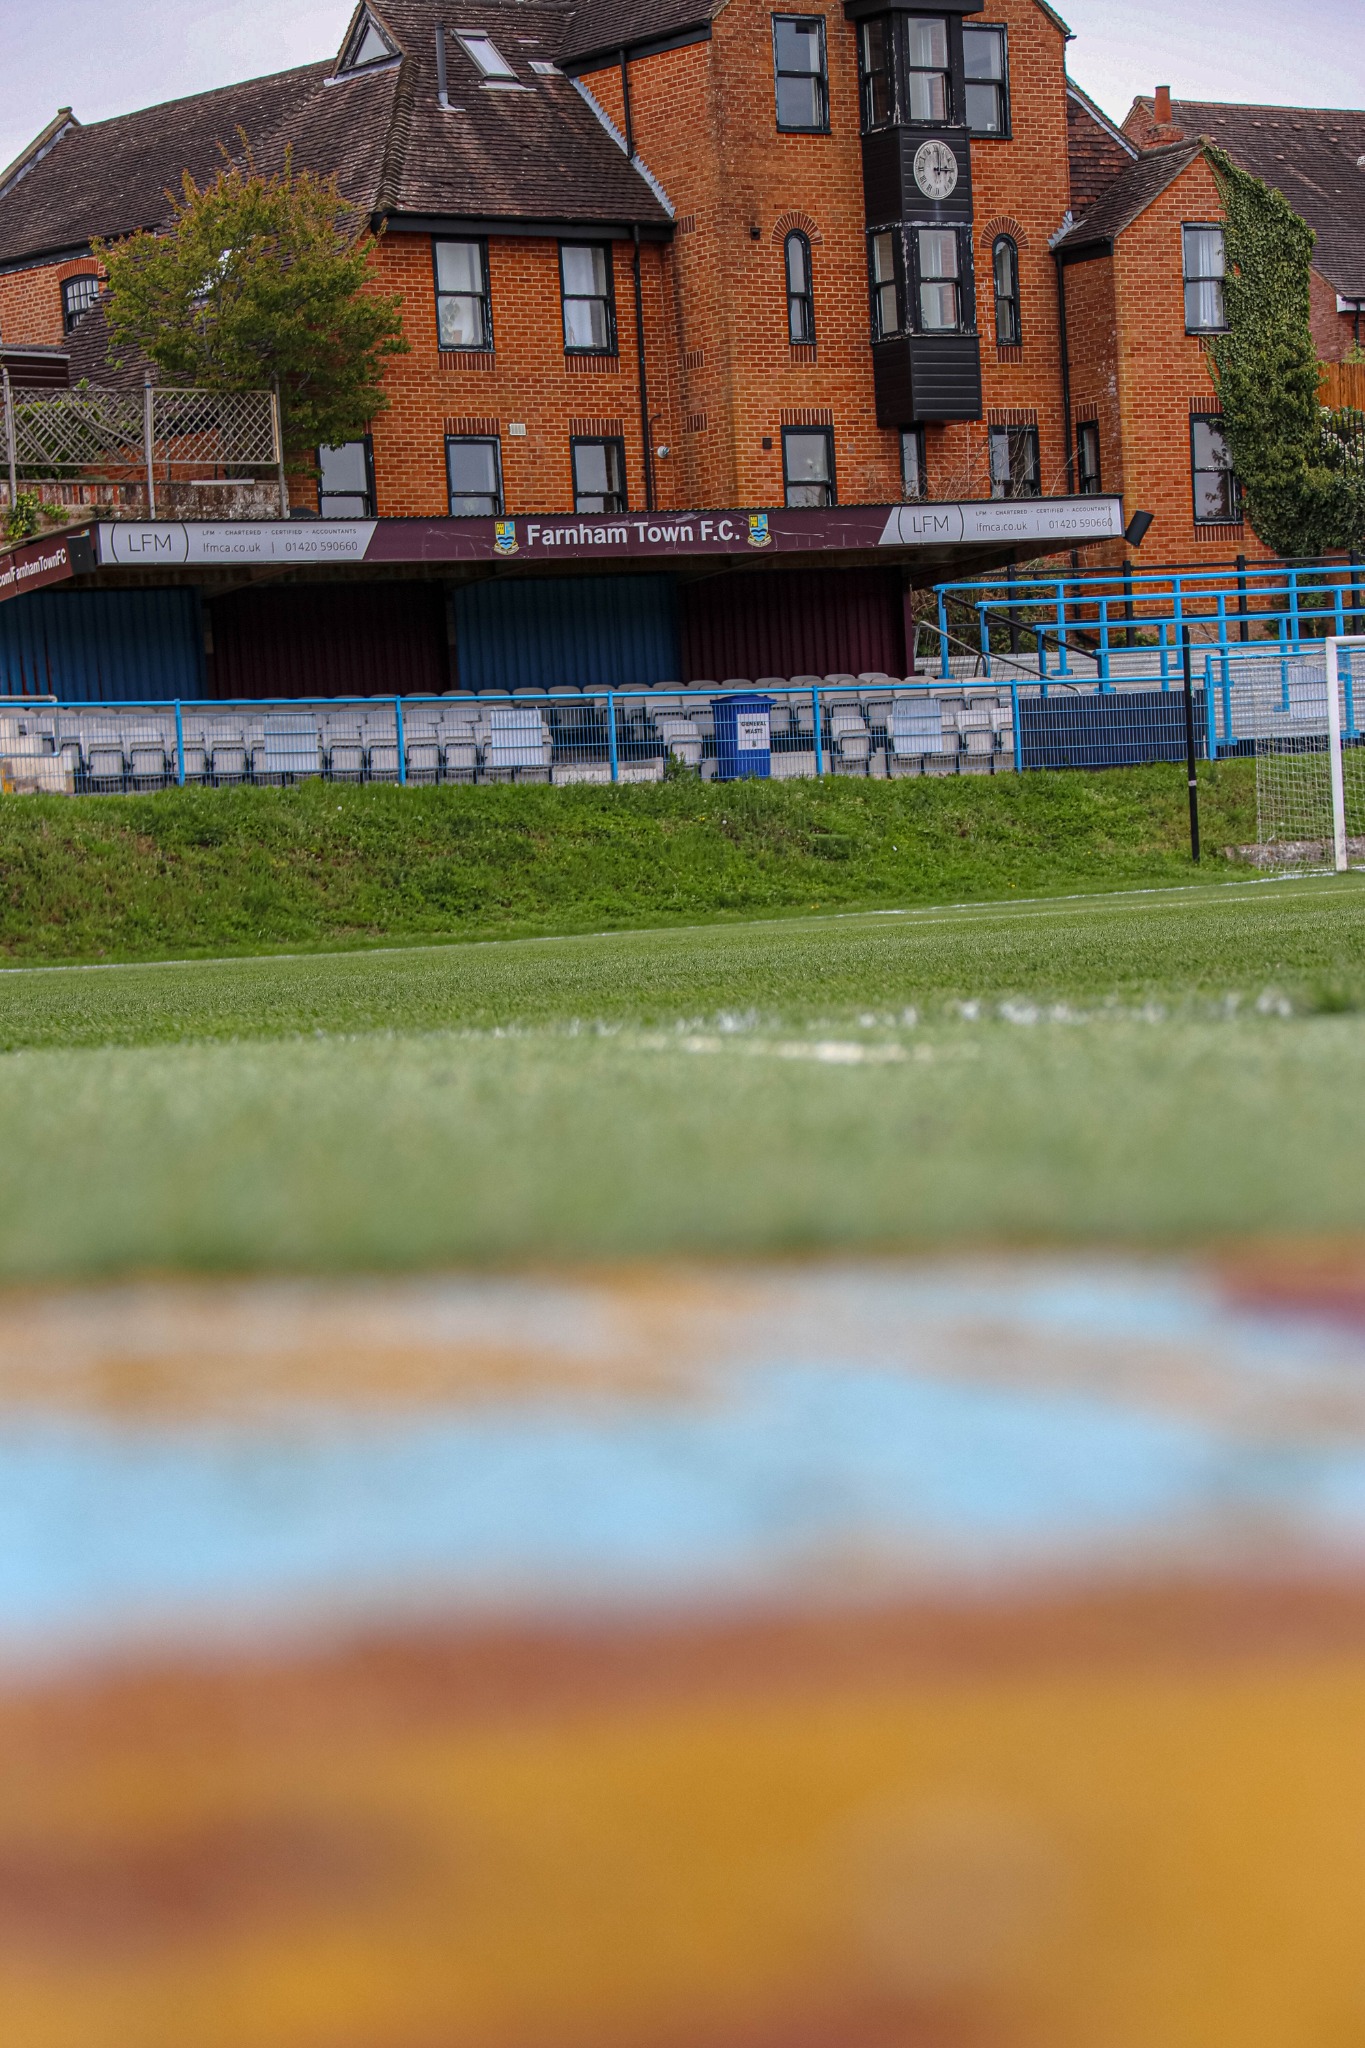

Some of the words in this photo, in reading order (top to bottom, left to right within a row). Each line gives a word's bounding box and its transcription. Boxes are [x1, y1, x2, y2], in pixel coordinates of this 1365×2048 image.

[527, 523, 628, 546] Farnham
[633, 521, 694, 543] Town
[700, 519, 740, 541] F.C.
[912, 515, 950, 533] LFM
[976, 521, 1028, 532] lfmca.co.uk
[1049, 519, 1077, 529] 01420
[1080, 517, 1113, 528] 590660
[128, 533, 172, 552] LFM
[202, 542, 261, 553] lfmca.co.uk
[285, 541, 318, 553] 01420
[320, 541, 358, 552] 590660
